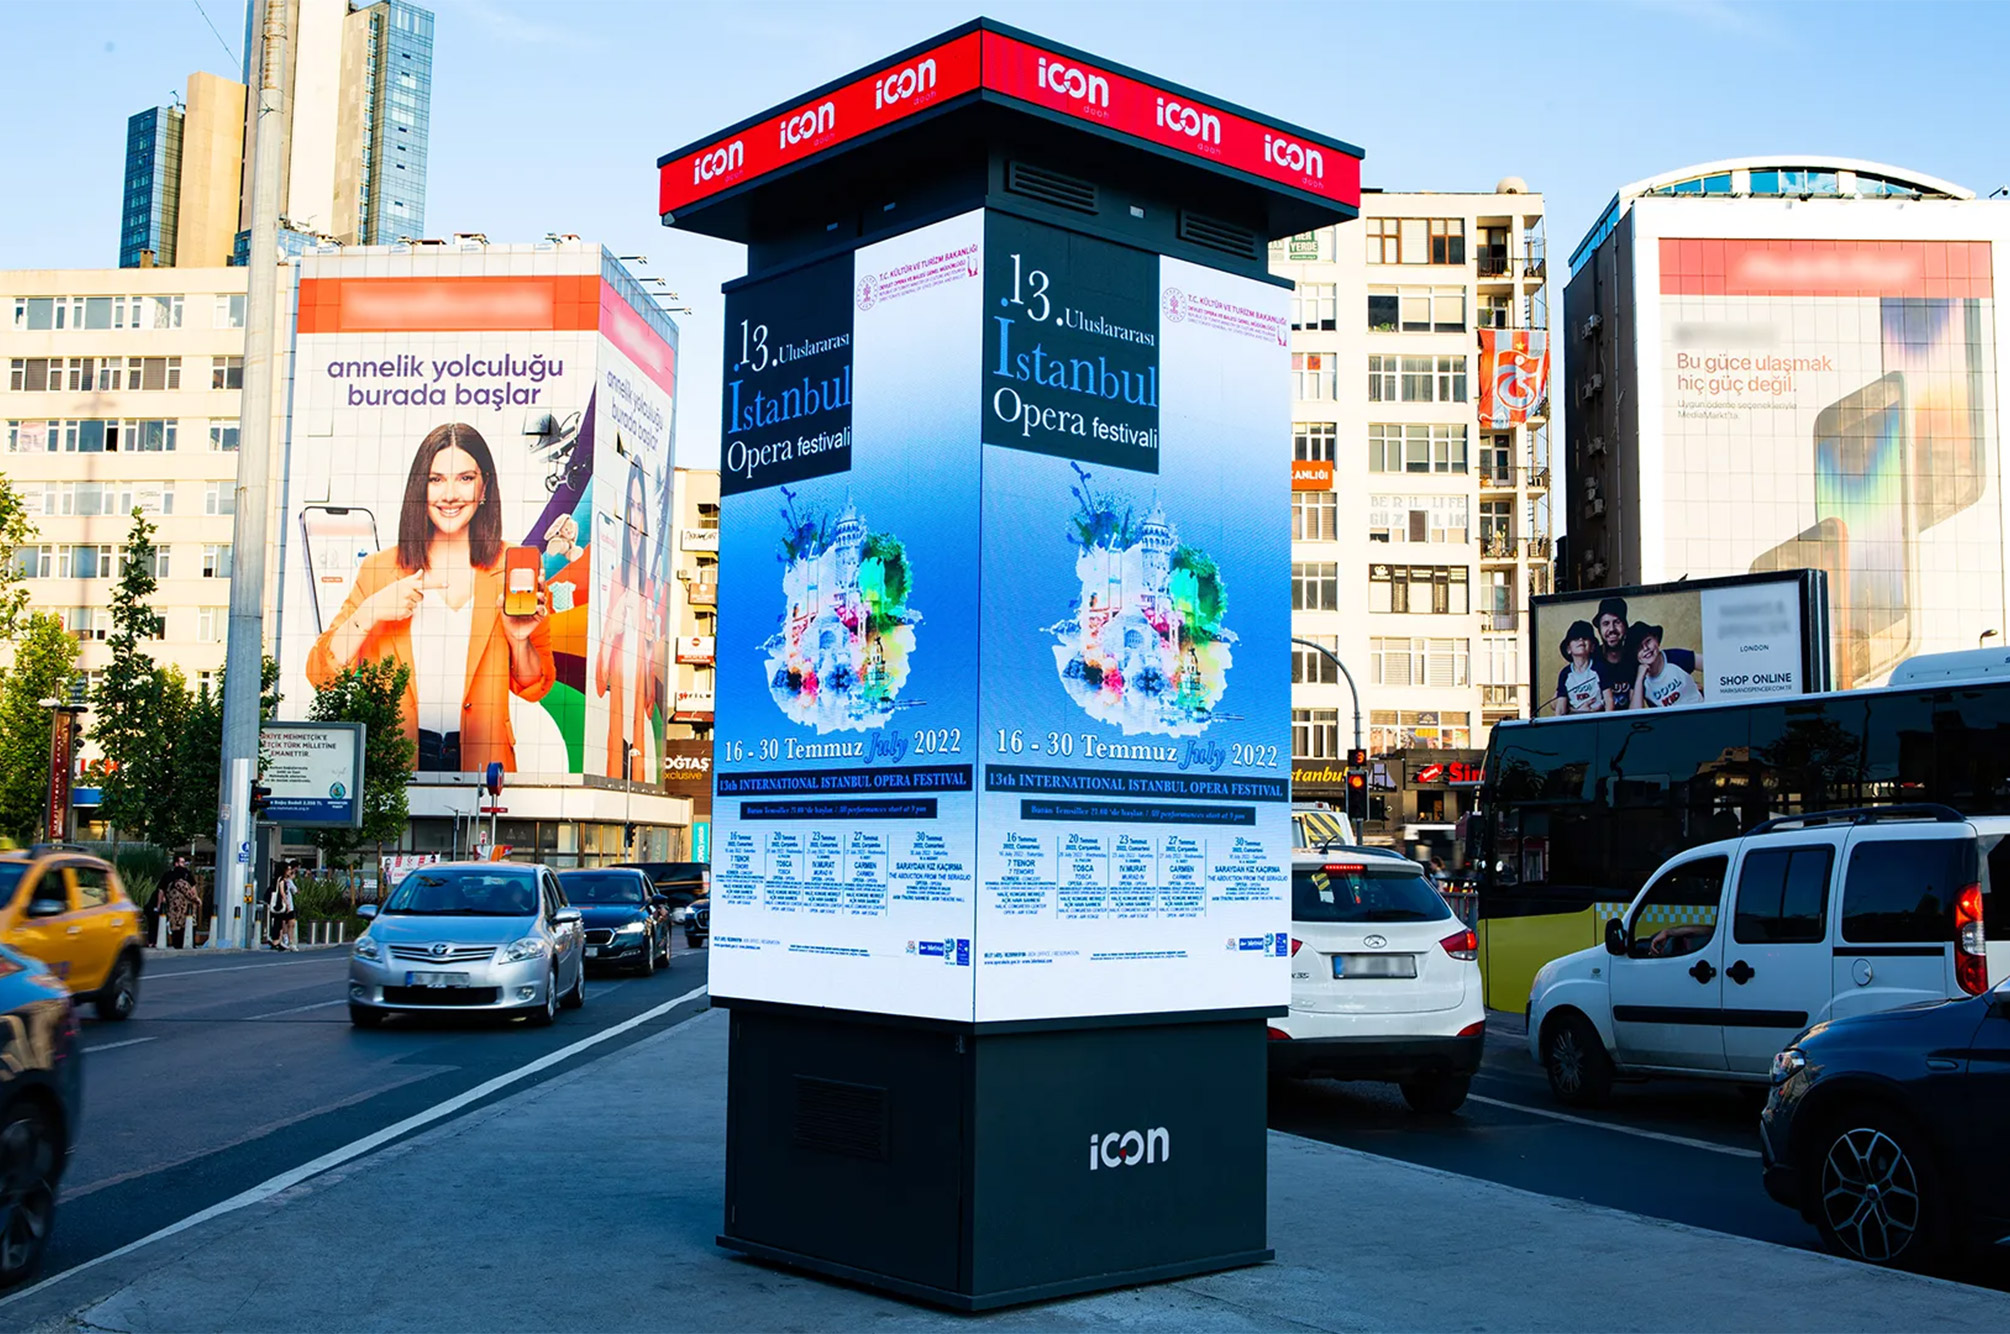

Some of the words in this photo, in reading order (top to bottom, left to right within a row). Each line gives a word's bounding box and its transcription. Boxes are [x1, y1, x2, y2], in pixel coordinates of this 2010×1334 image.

[875, 58, 936, 110] icon
[1038, 57, 1109, 107] icon
[780, 101, 835, 150] icon
[1157, 98, 1220, 145] icon
[694, 140, 743, 185] icon
[1265, 134, 1323, 179] icon
[327, 354, 424, 379] annelik
[432, 353, 564, 383] yolculuğu
[993, 297, 1157, 408] İstanbul
[1677, 353, 1700, 369] Bu
[1705, 353, 1751, 373] güce
[1755, 355, 1832, 376] ulaşmak
[347, 382, 446, 406] burada
[455, 381, 542, 411] başlar
[727, 363, 852, 435] İstanbul
[1678, 375, 1704, 395] hiç
[1709, 375, 1744, 396] güç
[1748, 376, 1797, 396] değil.
[994, 387, 1086, 437] Opera
[1092, 417, 1158, 448] festivali
[727, 440, 793, 479] Opera
[797, 426, 851, 457] festivali
[1740, 644, 1769, 652] LONDON
[1720, 675, 1749, 686] SHOP
[1752, 672, 1792, 684] ONLINE
[725, 740, 743, 762] 16
[759, 739, 779, 760] 30
[784, 737, 863, 759] Temmuz
[863, 730, 908, 764] July
[914, 728, 961, 754] 2022
[997, 729, 1023, 754] 16
[1047, 732, 1073, 756] 30
[1081, 734, 1177, 763] Temmuz
[1178, 740, 1226, 773] July
[1232, 743, 1279, 768] 2022
[719, 778, 738, 791] 13th
[739, 775, 818, 791] INTERNATIONAL
[821, 775, 871, 789] ISTANBUL
[874, 773, 911, 787] OPERA
[913, 772, 966, 787] FESTIVAL
[989, 772, 1016, 785] 13th
[1019, 774, 1125, 791] INTERNATIONAL
[1128, 779, 1187, 793] ISTANBUL
[1189, 782, 1229, 795] OPERA
[1231, 783, 1283, 797] FESTIVAL
[1068, 834, 1079, 843] 20
[1119, 835, 1129, 844] 23
[1168, 835, 1178, 845] 27
[1235, 837, 1244, 846] 30
[1013, 859, 1035, 867] TENOR
[1090, 1126, 1169, 1170] icon
